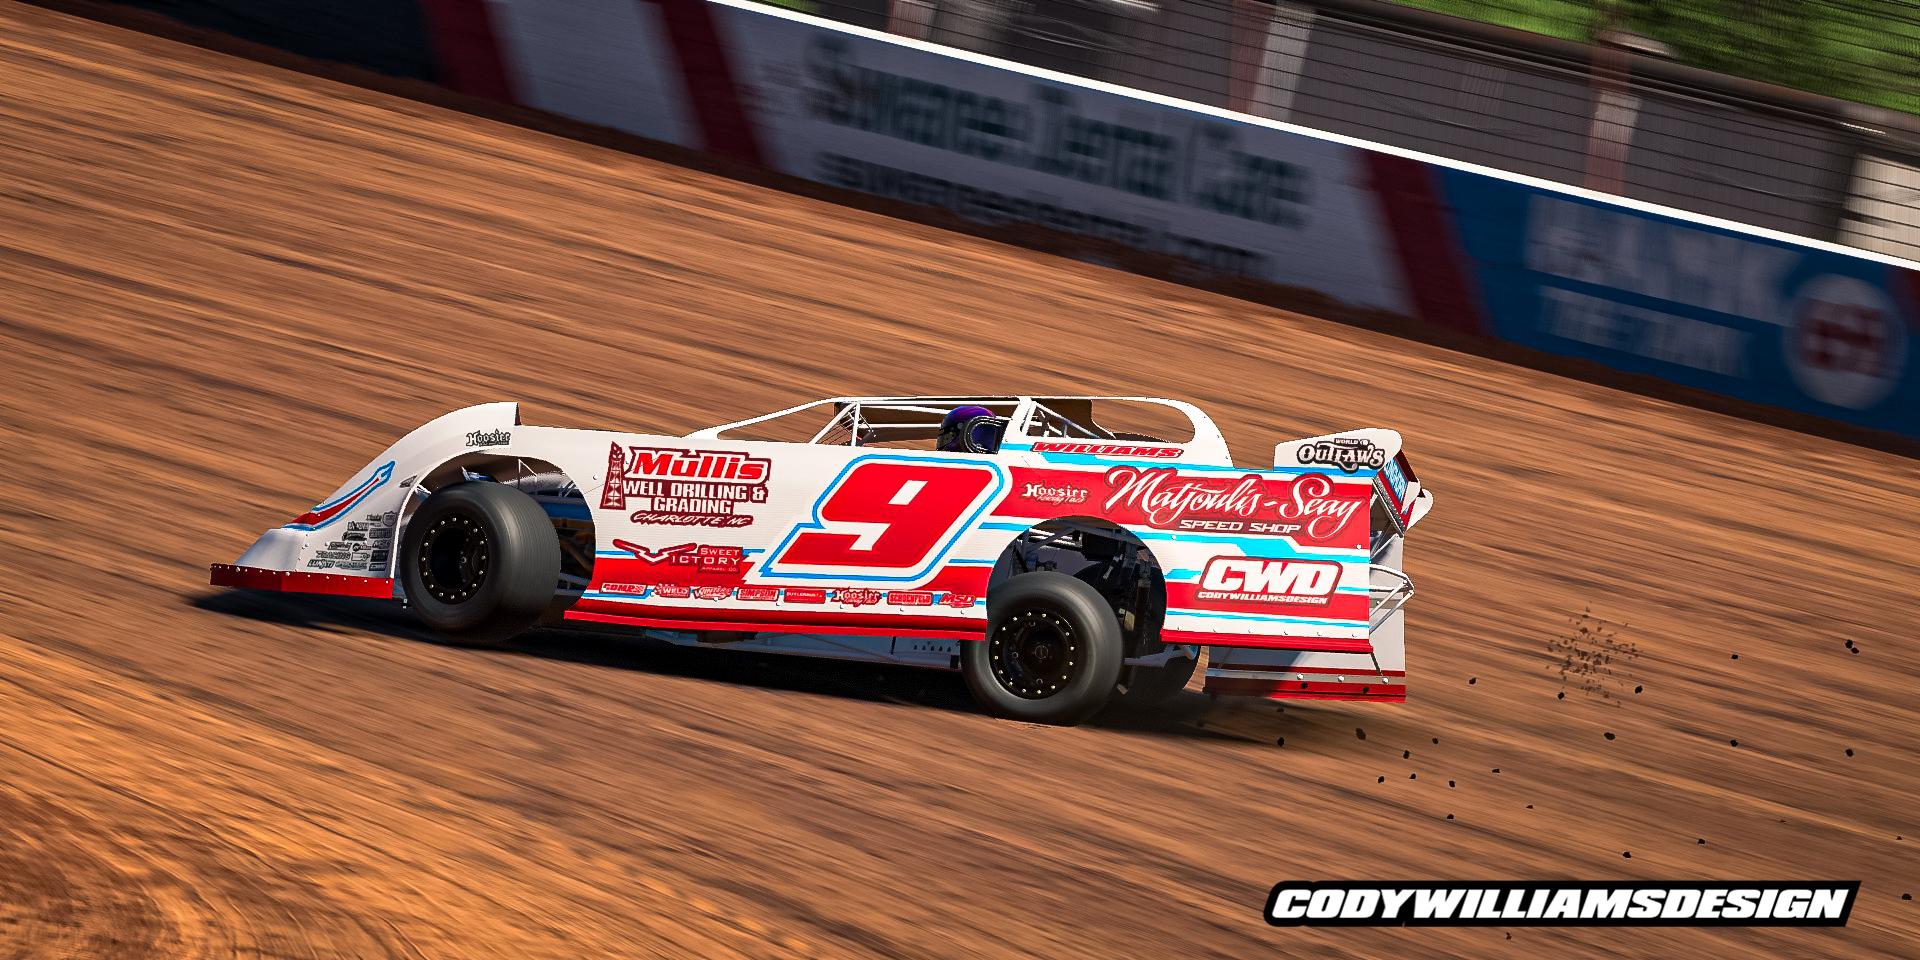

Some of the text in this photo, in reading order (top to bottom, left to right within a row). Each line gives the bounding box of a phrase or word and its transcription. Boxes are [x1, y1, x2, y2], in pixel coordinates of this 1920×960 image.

[466, 429, 511, 446] Hoosier
[1033, 442, 1182, 458] WILLIAMS
[633, 452, 765, 479] Mullis
[622, 480, 766, 500] WELL DRILLING &
[1022, 483, 1088, 497] Hoosier
[653, 497, 733, 514] GRADING
[727, 516, 751, 525] NC
[777, 462, 994, 568] 9
[1179, 519, 1301, 533] SPEED SHOP
[700, 547, 740, 556] SWEET
[1201, 558, 1339, 595] CWD
[1197, 591, 1328, 604] CODYWILLIAMSDESIGN
